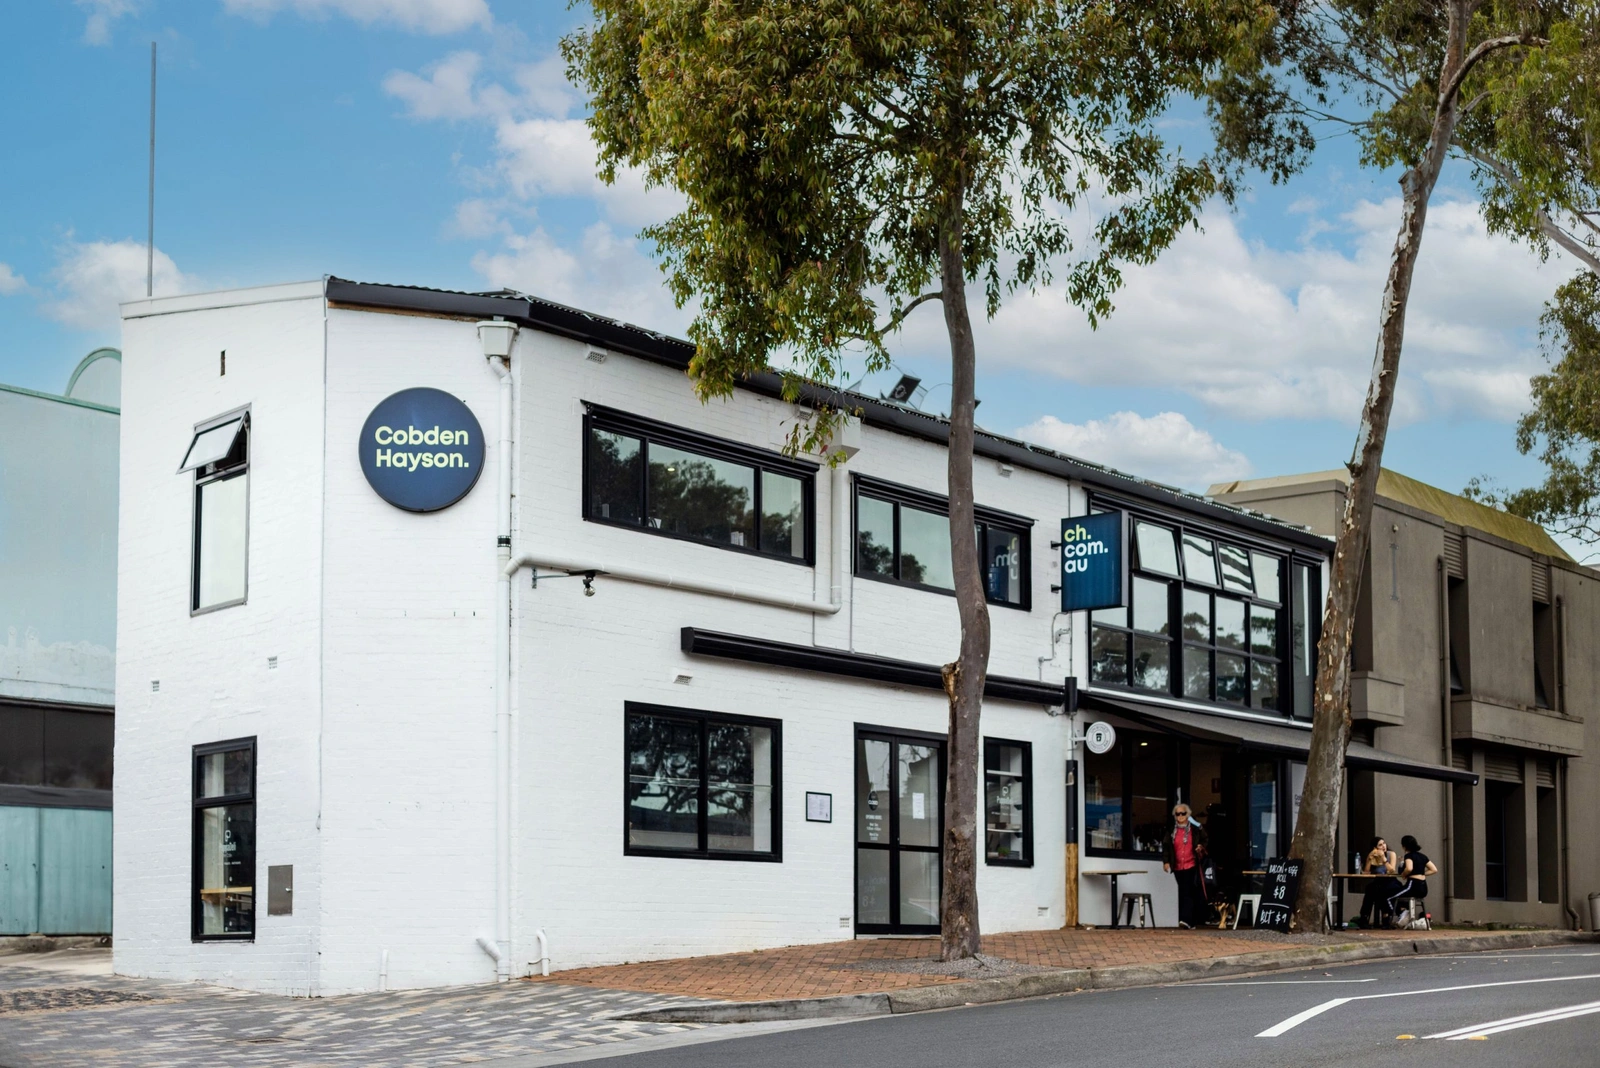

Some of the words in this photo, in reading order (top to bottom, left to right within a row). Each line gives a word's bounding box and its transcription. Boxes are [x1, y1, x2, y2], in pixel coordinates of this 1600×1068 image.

[375, 425, 469, 446] Cobden
[376, 448, 469, 472] Hayson.
[1064, 524, 1091, 542] ch.
[1064, 540, 1109, 558] com.
[1064, 558, 1088, 574] au
[1273, 885, 1286, 900] $8
[1275, 911, 1287, 924] $9
